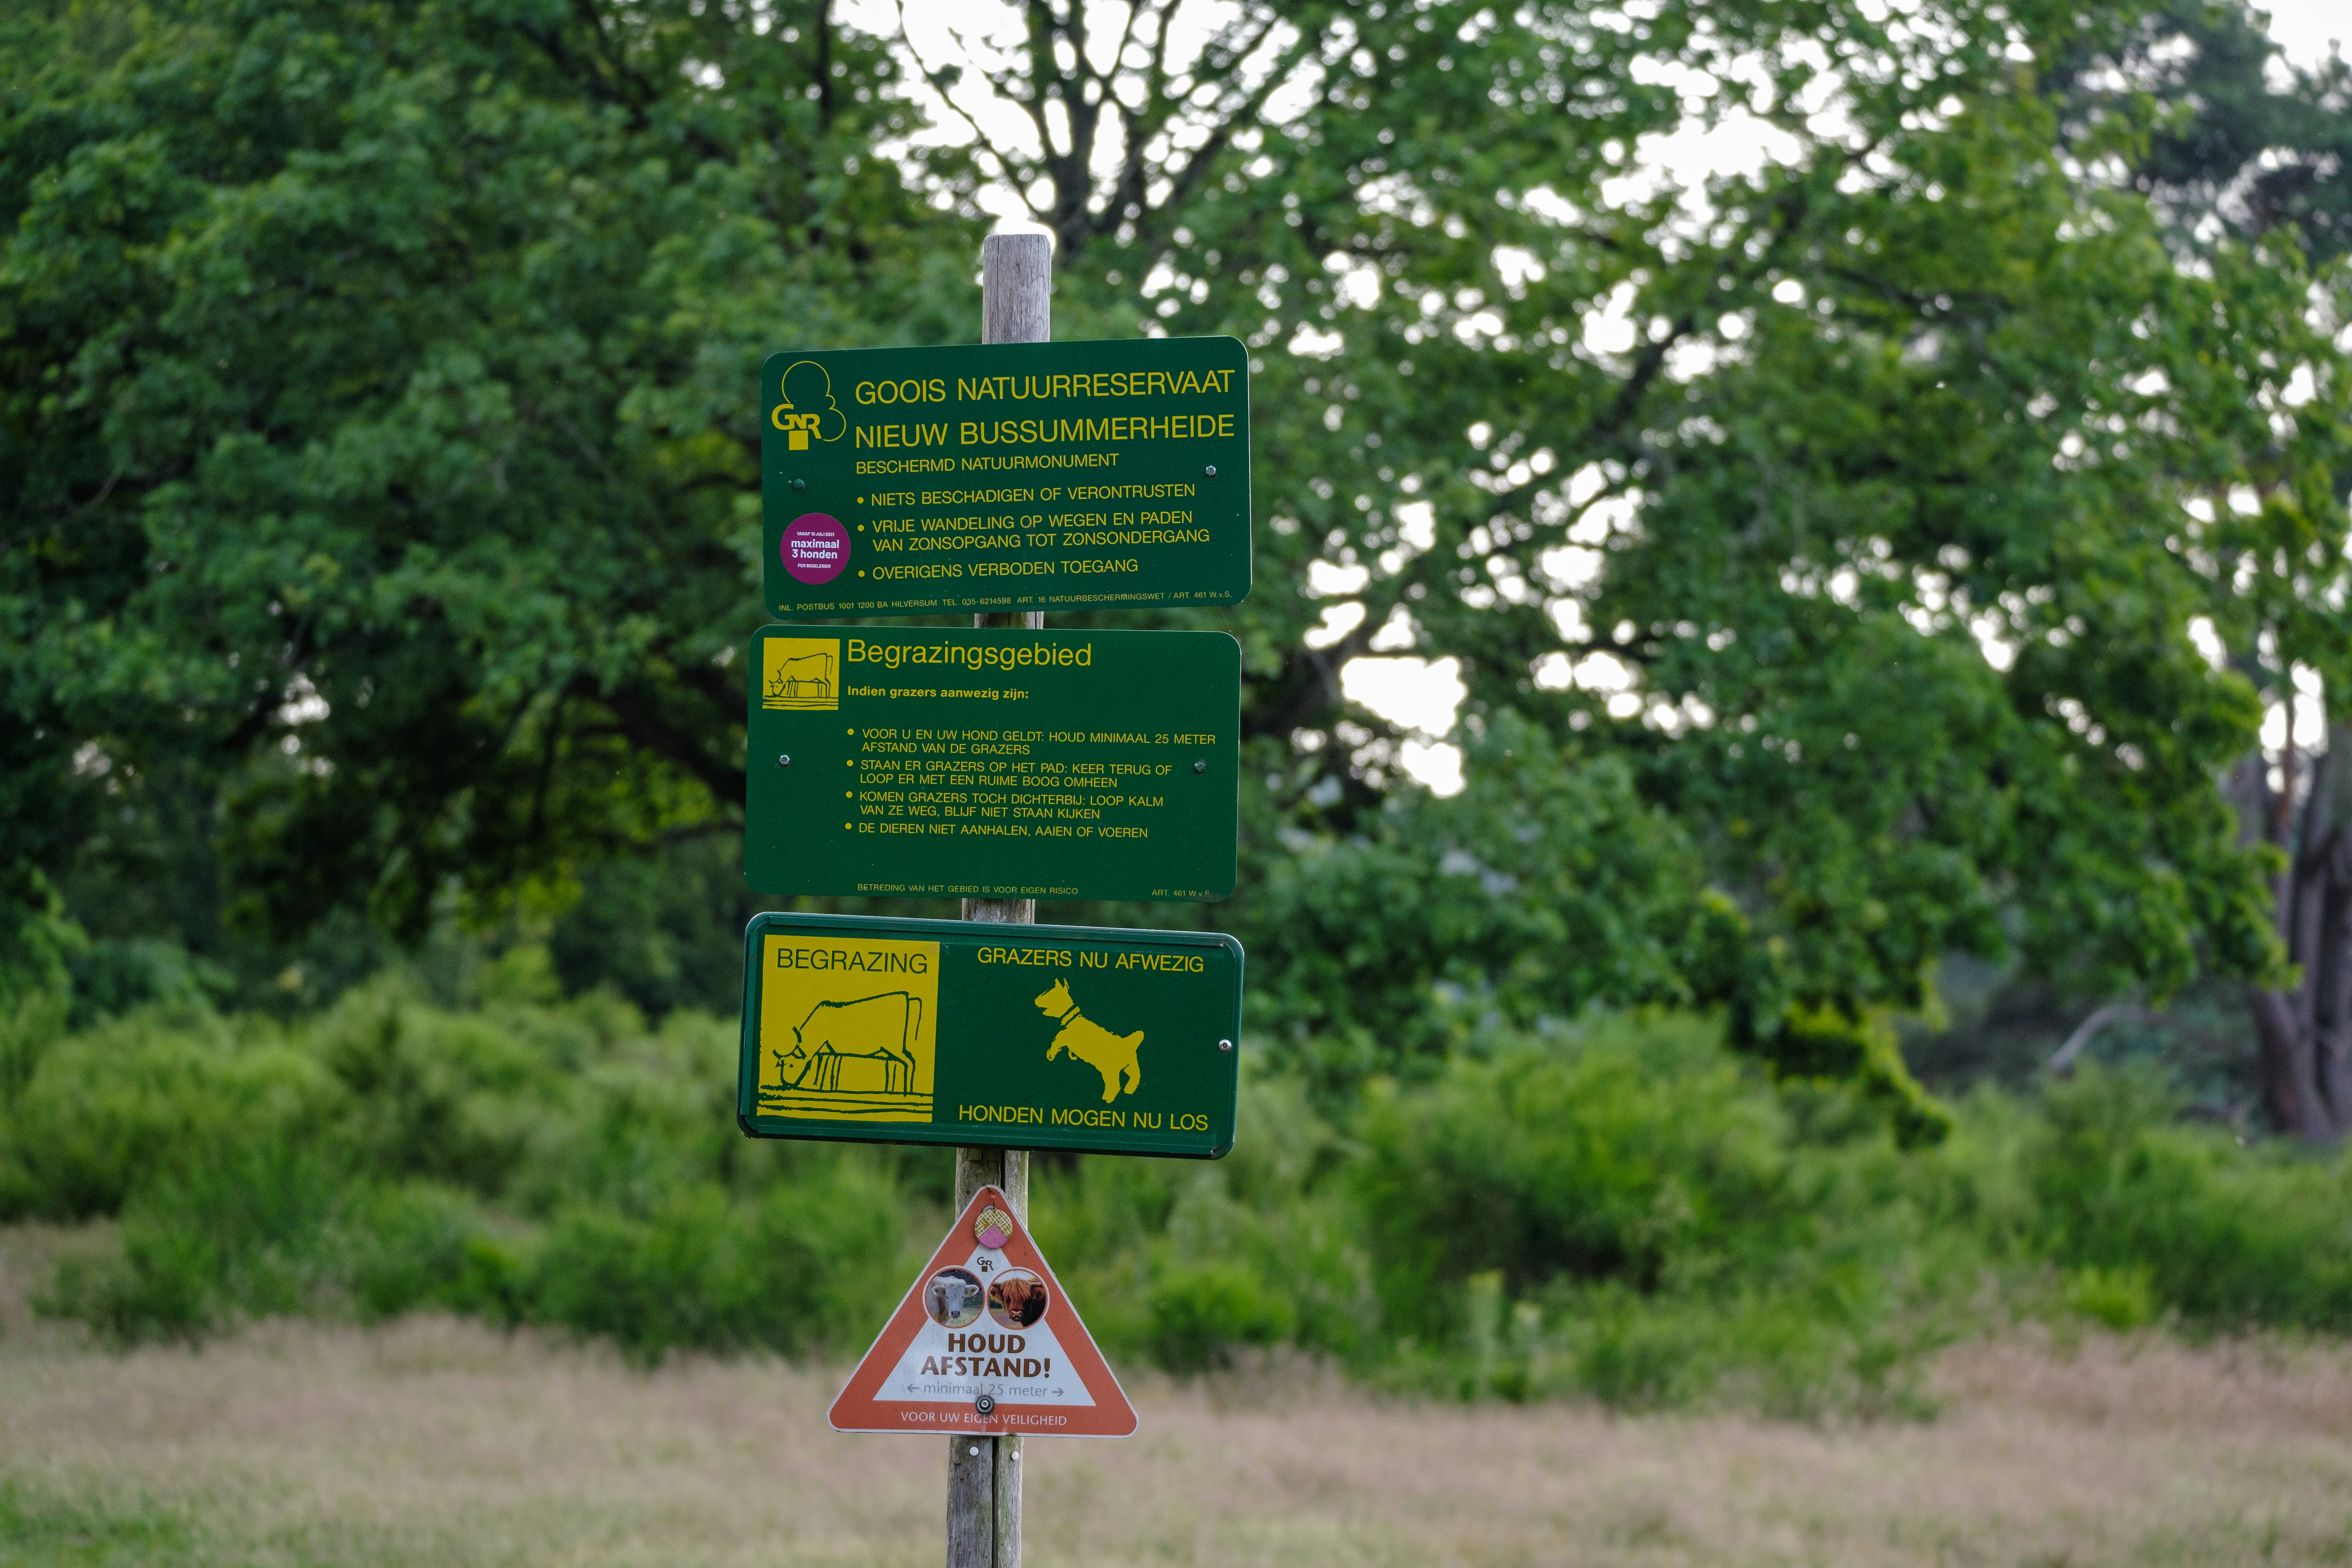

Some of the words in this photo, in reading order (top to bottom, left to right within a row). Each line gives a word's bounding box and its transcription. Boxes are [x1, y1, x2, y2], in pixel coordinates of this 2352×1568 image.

[856, 379, 946, 404] GOOIS
[959, 370, 1235, 400] NATUURRESERVAAT
[772, 404, 821, 439] GNR
[856, 423, 948, 448] NIEUW
[961, 414, 1234, 444] BUSSUMMERHEIDE
[857, 459, 955, 474] BESCHERMD
[962, 453, 1119, 470] NATUURMONUMENT
[872, 492, 915, 506] NIETS
[922, 489, 1034, 504] BESCHADIGEN
[1040, 488, 1061, 501] OF
[1068, 484, 1194, 499] VERONTRUSTEN
[873, 519, 914, 533] VRIJE
[921, 516, 1014, 531] WANDELING
[1020, 515, 1042, 528] OP
[1049, 513, 1106, 527] WEGEN
[1114, 513, 1133, 525] EN
[1141, 511, 1192, 524] PADEN
[791, 539, 839, 548] maximaal
[873, 539, 902, 551] VAN
[909, 535, 1020, 550] ZONSOPGANG
[1026, 534, 1056, 547] TOT
[1063, 529, 1209, 545] ZONSONDERGANG
[792, 549, 798, 558] 3
[801, 549, 837, 559] honden
[873, 564, 962, 579] OVERIGENS
[968, 562, 1054, 576] VERBODEN
[1061, 559, 1138, 573] TOEGANG
[962, 597, 1011, 606] 035-6214598
[1049, 593, 1164, 602] NATUURBESCHERMINGSWET
[848, 639, 1091, 670] Begrazingsgebied
[848, 686, 885, 696] Indien
[890, 688, 936, 700] grazers
[941, 688, 998, 700] aanwezig
[1003, 689, 1028, 700] zijn:
[862, 729, 897, 738] VOOR
[902, 729, 911, 739] U
[916, 730, 932, 739] EN
[937, 730, 957, 740] UW
[962, 730, 998, 740] HOND
[1003, 731, 1043, 741] GELDT:
[1049, 732, 1085, 742] HOUD
[1090, 733, 1150, 743] MINIMAAL
[1155, 733, 1169, 744] 25
[1174, 734, 1215, 744] METER
[862, 742, 917, 752] AFSTAND
[922, 743, 945, 753] VAN
[951, 744, 966, 753] DE
[971, 744, 1030, 755] GRAZERS
[861, 760, 900, 770] STAAN
[905, 761, 920, 770] ER
[926, 761, 984, 772] GRAZERS
[989, 761, 1007, 772] OP
[1012, 763, 1035, 772] HET
[1041, 763, 1067, 773] PAD:
[1073, 764, 1104, 773] KEER
[1109, 764, 1150, 775] TERUG
[1156, 765, 1171, 775] OF
[861, 773, 893, 783] LOOP
[899, 774, 914, 784] ER
[920, 775, 945, 784] MET
[951, 775, 974, 785] EEN
[979, 775, 1017, 786] RUIME
[1023, 776, 1059, 787] BOOG
[1064, 777, 1117, 787] OMHEEN
[860, 792, 903, 801] KOMEN
[909, 792, 967, 803] GRAZERS
[972, 793, 1006, 803] TOCH
[1012, 794, 1084, 805] DICHTERBIJ:
[1090, 796, 1124, 805] LOOP
[1129, 796, 1163, 806] KALM
[861, 805, 883, 815] VAN
[888, 805, 903, 815] ZE
[908, 806, 939, 817] WEG,
[945, 806, 976, 816] BLIJF
[982, 807, 1008, 817] NIET
[1014, 807, 1052, 818] STAAN
[1058, 808, 1099, 819] KIJKEN
[859, 823, 874, 833] DE
[880, 823, 924, 833] DIEREN
[929, 824, 956, 834] NIET
[961, 825, 1030, 836] AANHALEN,
[1035, 826, 1072, 836] AAIEN
[1077, 827, 1093, 836] OF
[1098, 827, 1147, 838] VOEREN
[778, 948, 927, 974] BEGRAZING
[978, 947, 1072, 966] GRAZERS
[1080, 952, 1107, 968] NU
[1115, 954, 1203, 972] AFWEZIG
[959, 1105, 1043, 1123] HONDEN
[1052, 1109, 1125, 1127] MOGEN
[1134, 1112, 1161, 1129] NU
[1170, 1114, 1208, 1130] LOS
[977, 1257, 994, 1271] GNR
[948, 1333, 1025, 1353] HOUD
[921, 1357, 1050, 1378] AFSTAND!
[924, 1382, 984, 1395] minimaal
[987, 1384, 1003, 1396] 25
[1009, 1386, 1047, 1396] meter
[901, 1412, 935, 1421] VOOR
[940, 1413, 960, 1422] UW
[964, 1413, 997, 1423] EIGEN
[1003, 1415, 1066, 1425] VEILIGHEID
